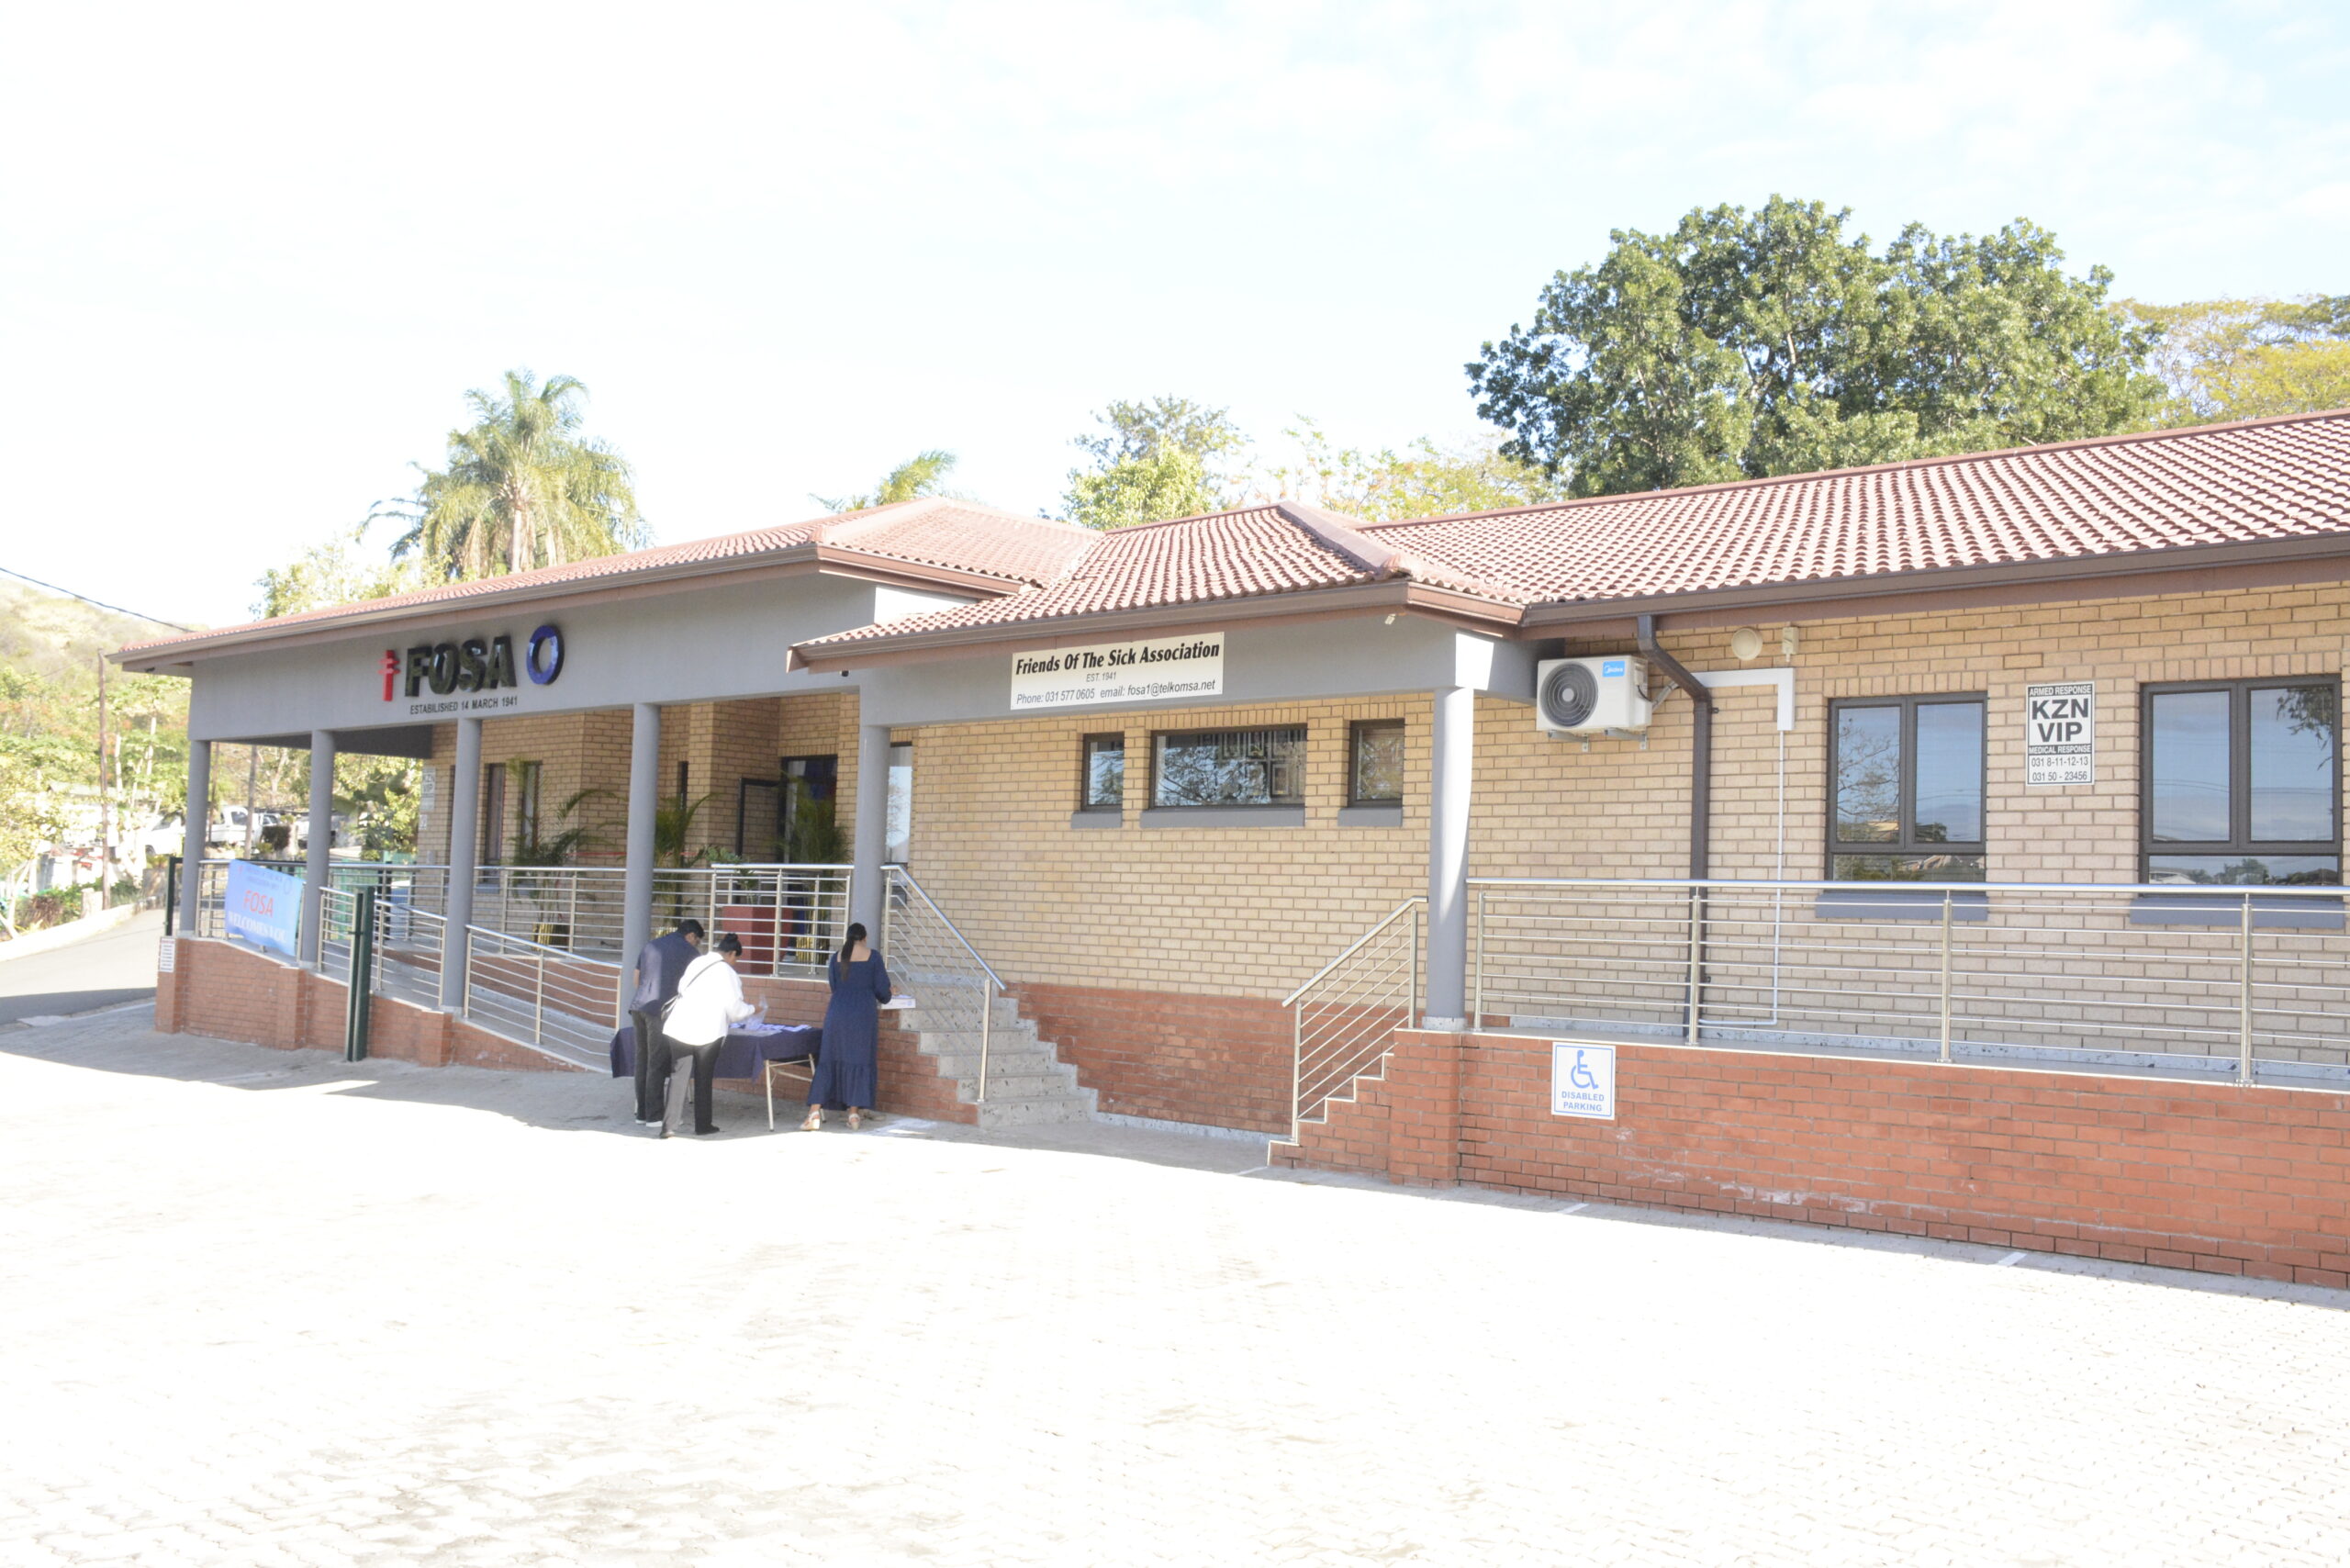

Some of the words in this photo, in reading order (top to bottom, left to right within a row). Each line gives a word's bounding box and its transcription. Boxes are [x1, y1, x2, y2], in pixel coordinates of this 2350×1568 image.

[1015, 656, 1060, 676] Friends
[1064, 654, 1080, 670] Of
[1082, 652, 1104, 669] The
[1108, 647, 1136, 666] Sick
[1139, 641, 1220, 664] Association
[405, 634, 518, 697] FOSA
[1102, 671, 1117, 681] 1941
[1016, 693, 1044, 705] Phone:
[1045, 690, 1058, 702] 031
[1059, 689, 1074, 700] 577
[1075, 689, 1095, 700] 0605
[1100, 687, 1125, 699] email:
[1127, 679, 1215, 697] fosa1@telkomsa.net
[2030, 688, 2053, 696] ARMED
[2054, 686, 2091, 694] RESPONSE
[461, 700, 470, 711] 14
[472, 698, 498, 709] MARCH
[502, 696, 518, 706] 1941
[2031, 698, 2089, 720] KZN
[2037, 722, 2083, 743] VIP
[2057, 745, 2092, 754] RESPONSE
[2031, 757, 2044, 767] 031
[2046, 756, 2088, 767] 8-11-12-13
[2032, 772, 2045, 781] 031
[2048, 771, 2057, 781] 50
[2065, 771, 2087, 780] 23456
[243, 890, 274, 918] FOSA
[1561, 1091, 1605, 1102] DISABLED
[1563, 1102, 1603, 1112] PARKING
